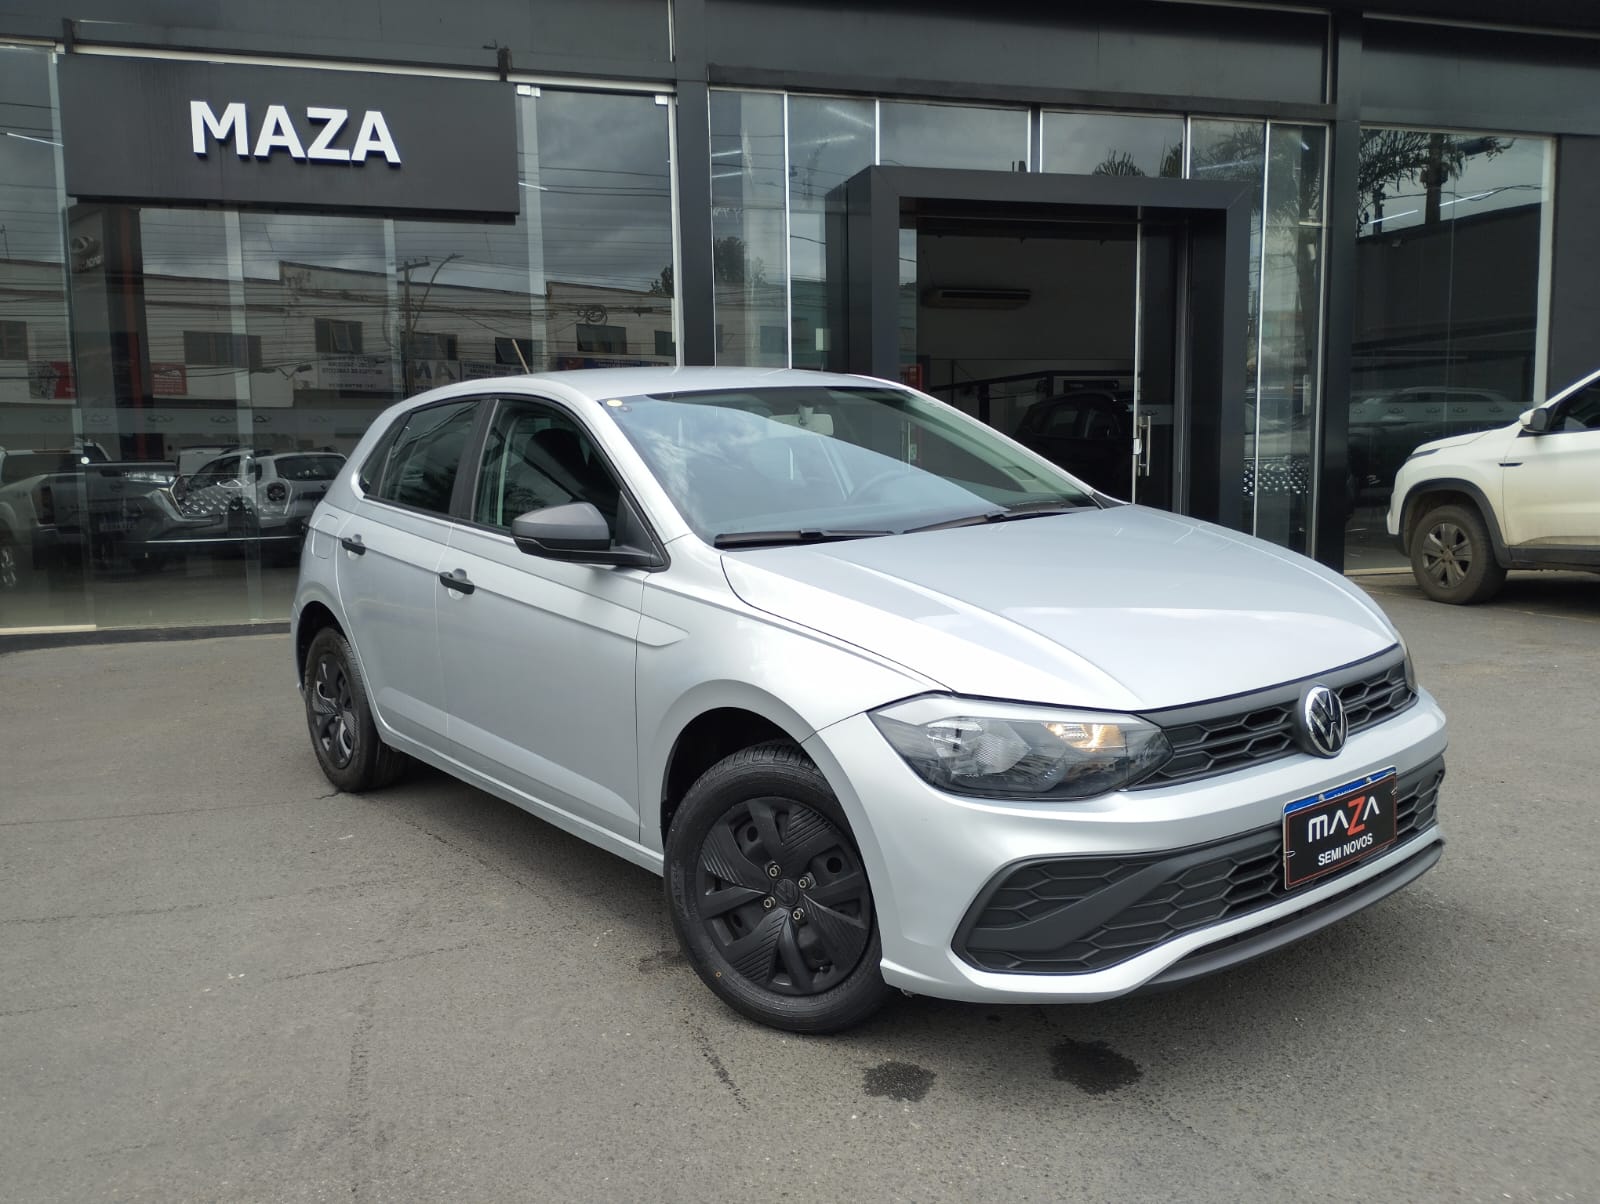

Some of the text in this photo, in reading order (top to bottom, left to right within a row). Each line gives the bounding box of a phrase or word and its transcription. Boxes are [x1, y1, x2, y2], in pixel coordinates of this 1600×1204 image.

[190, 100, 402, 167] MAZA
[1317, 832, 1374, 866] SEMI NOVOS
